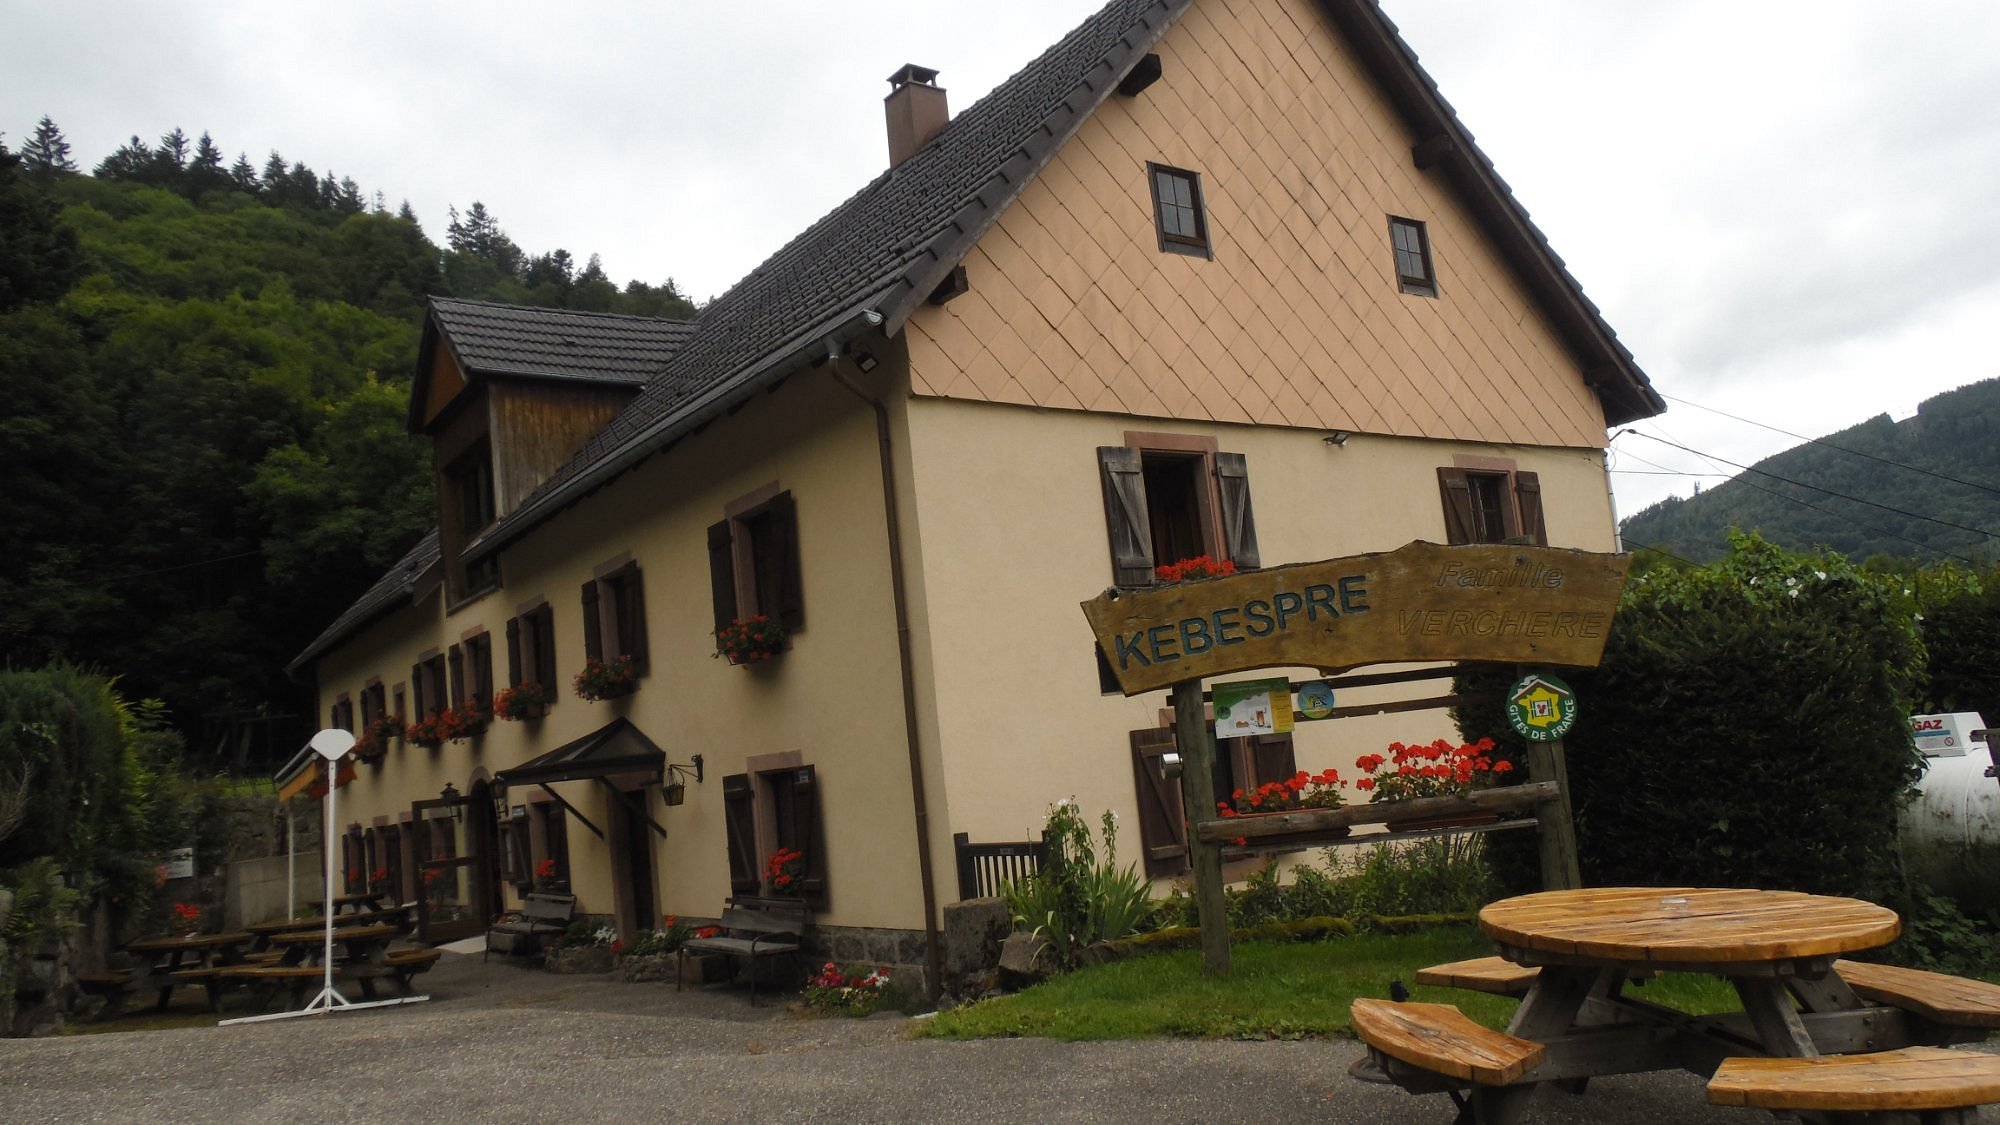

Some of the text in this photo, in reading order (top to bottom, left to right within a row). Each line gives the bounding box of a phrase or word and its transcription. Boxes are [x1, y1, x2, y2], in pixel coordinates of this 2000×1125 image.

[1436, 561, 1564, 588] Famille
[1115, 575, 1371, 671] KEBESPRE
[1398, 609, 1606, 639] VERCHERE
[1531, 730, 1547, 740] DE
[1551, 699, 1575, 738] FRANCE
